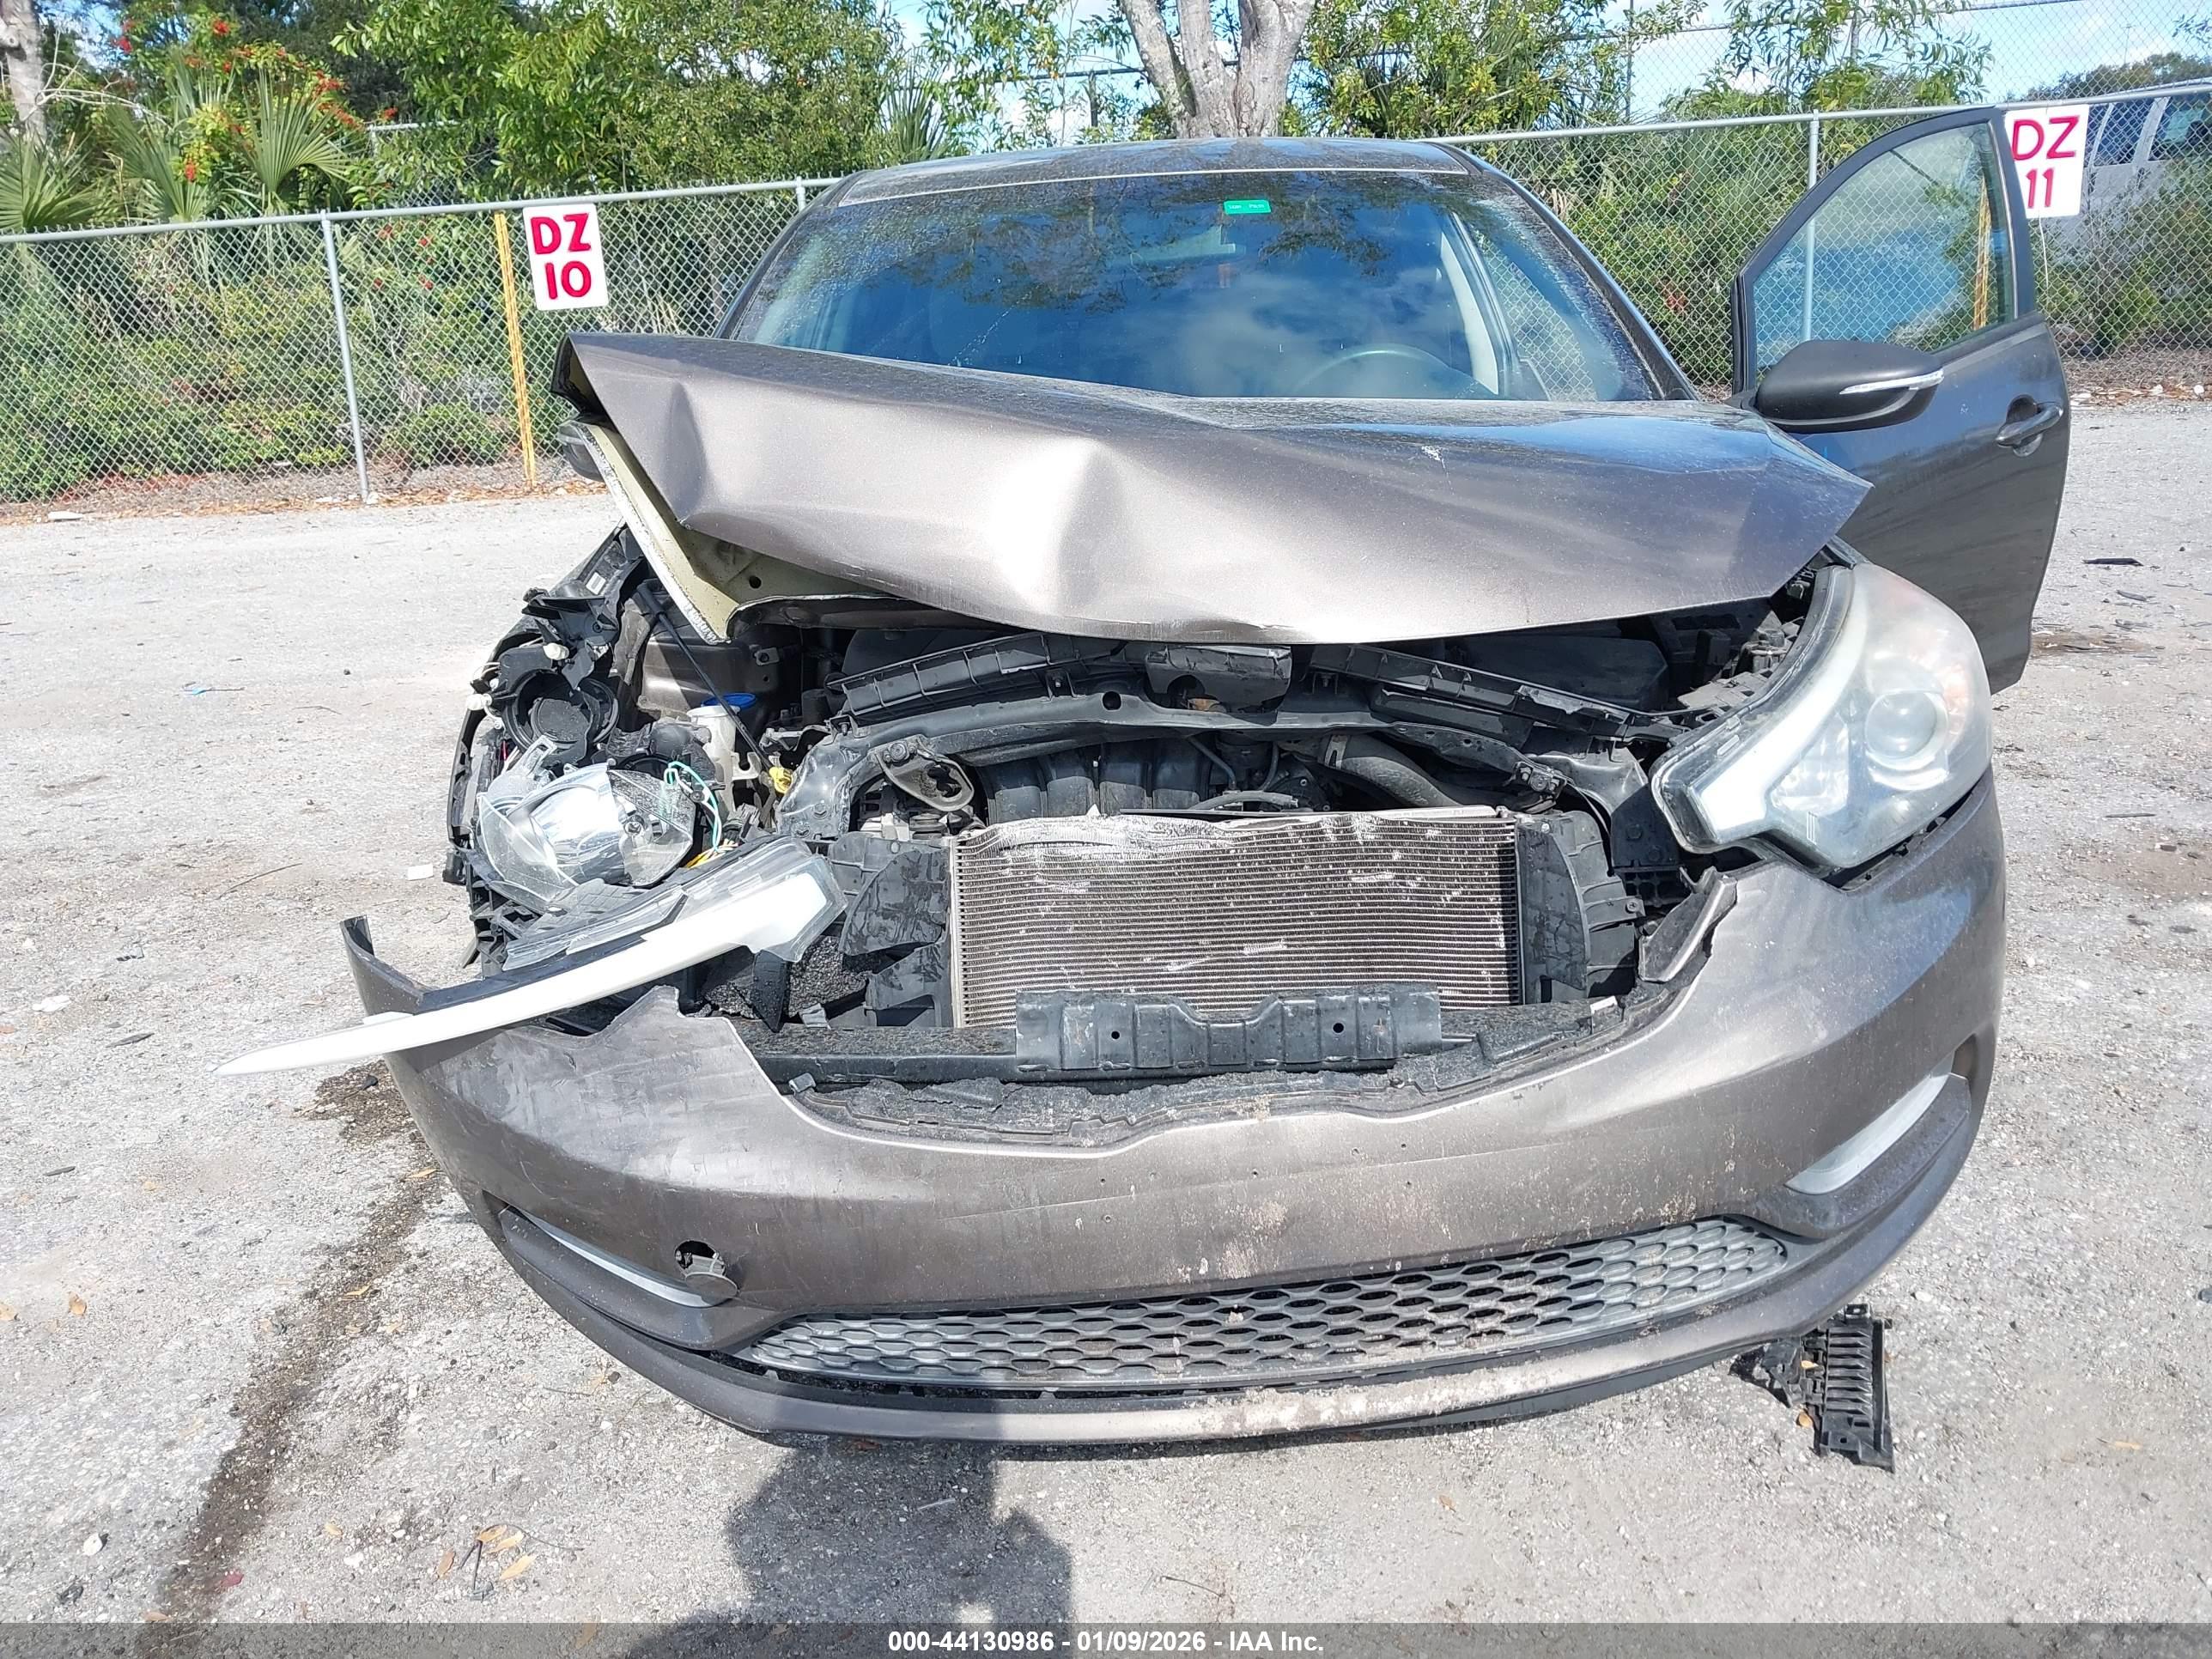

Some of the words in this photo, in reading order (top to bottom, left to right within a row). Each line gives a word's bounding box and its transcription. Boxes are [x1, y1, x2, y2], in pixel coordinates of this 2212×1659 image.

[2012, 115, 2080, 161] DZ
[2026, 167, 2055, 209] 11
[530, 213, 592, 254] DZ
[544, 260, 592, 300] 10
